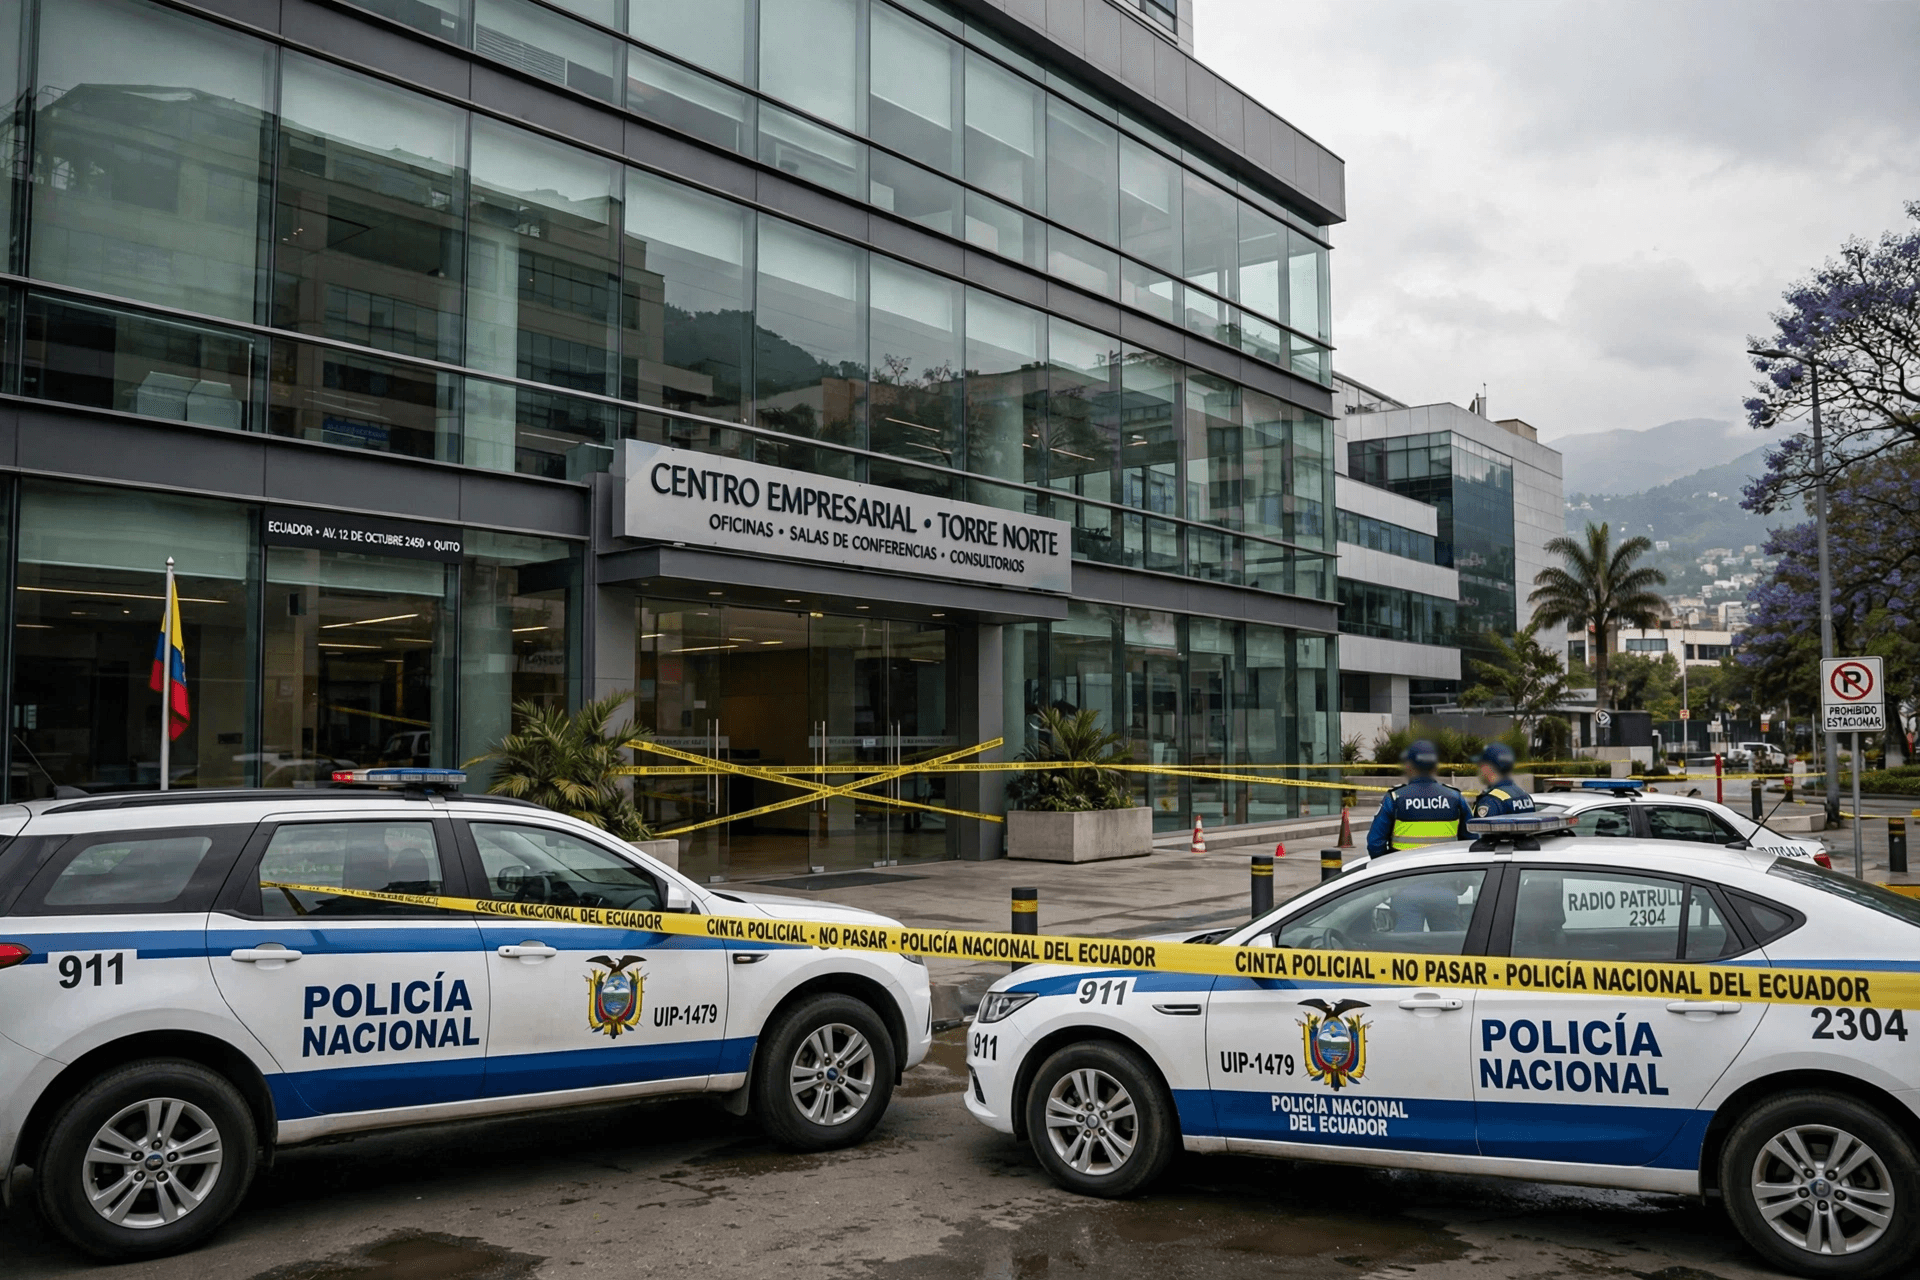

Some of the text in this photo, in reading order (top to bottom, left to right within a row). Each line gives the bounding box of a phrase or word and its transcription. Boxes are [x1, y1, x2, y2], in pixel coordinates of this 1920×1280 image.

[651, 463, 1059, 557] CENTRO EMPRESARIAL TORRE NORTE
[268, 521, 461, 553] ECUADOR AV. 12 DE OCTUBRE 2450 QUITO
[709, 513, 1025, 573] OFICINAS SALAS DE CONFERENCIAS CONSULTORIOS
[1827, 717, 1881, 727] ESTACIONAR
[1829, 706, 1877, 715] PROHIBIDO
[1405, 796, 1450, 810] POLICÍA
[1568, 888, 1701, 911] RADIO PATRULL
[520, 904, 577, 922] NACIONAL
[580, 908, 603, 924] DEL
[606, 910, 663, 931] ECUADOR
[1629, 908, 1666, 927] 2304
[707, 918, 1156, 968] CINTA POLICIAL NO PASAR POLICÍA NACIONAL DEL ECUADOR
[58, 952, 124, 989] 911
[1235, 951, 1871, 1003] CINTA POLICIAL NO PASAR POLICÍA NACIONAL DEL ECUADOR
[303, 971, 473, 1020] POLICÍA
[1079, 979, 1128, 1006] 911
[654, 1004, 717, 1027] UIP-1479
[1811, 1007, 1908, 1042] 2304
[302, 1017, 480, 1057] NACIONAL
[973, 1032, 998, 1061] 911
[1481, 1012, 1663, 1057] POLICÍA
[1220, 1051, 1295, 1076] UIP-1479
[1480, 1058, 1669, 1096] NACIONAL
[1271, 1094, 1409, 1119] POLICÍA NACIONAL
[1289, 1114, 1388, 1137] DEL ECUADOR
